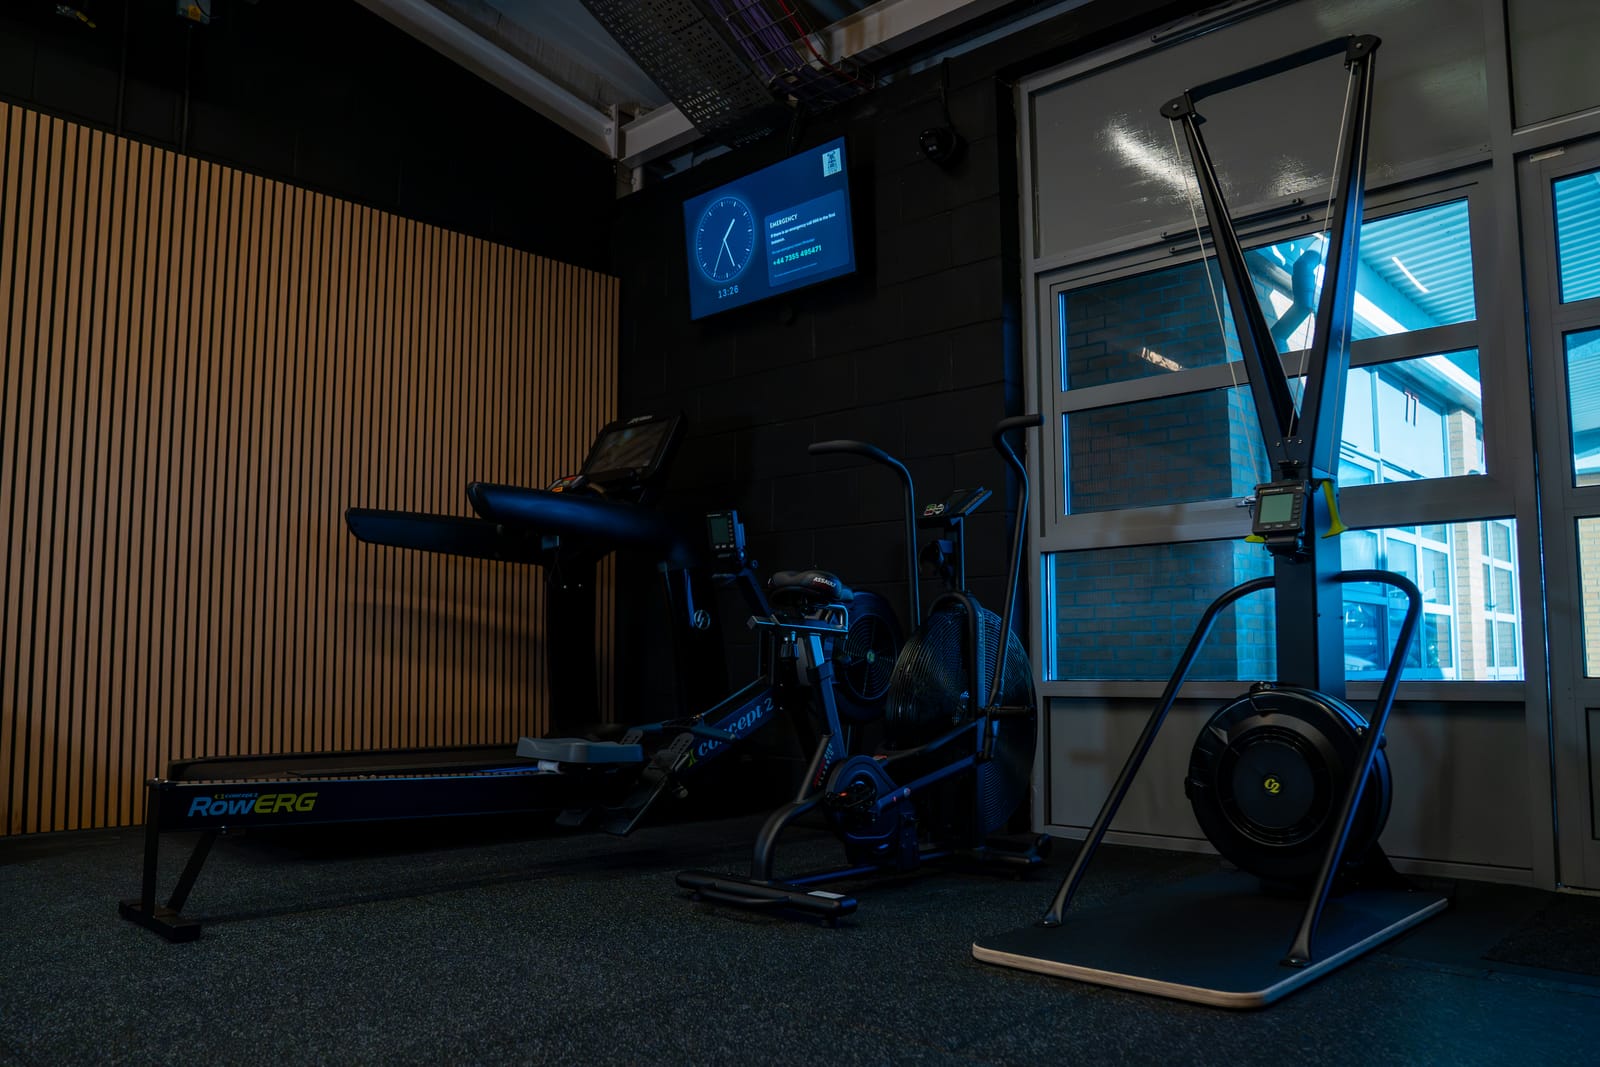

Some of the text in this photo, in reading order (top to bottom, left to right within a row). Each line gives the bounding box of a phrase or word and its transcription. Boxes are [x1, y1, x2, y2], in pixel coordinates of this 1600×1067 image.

[770, 214, 797, 228] EMERGENCY
[718, 285, 739, 298] 13:26
[698, 697, 774, 757] cocept 2
